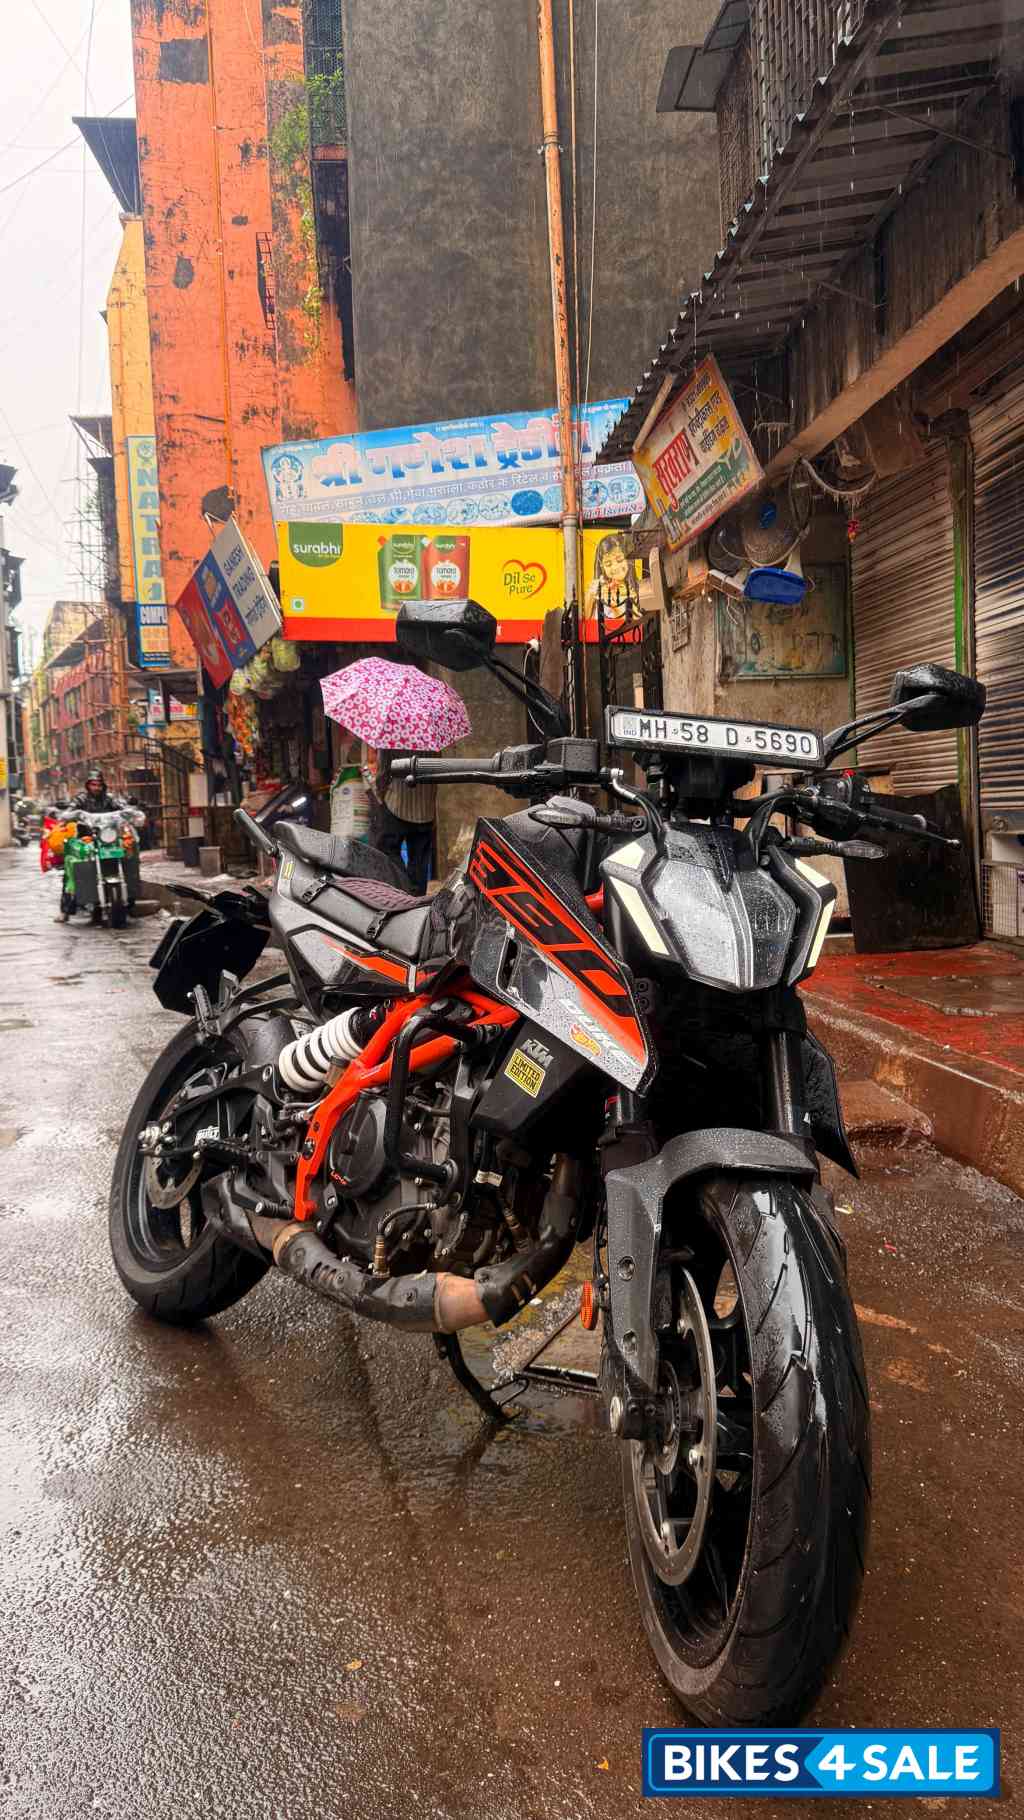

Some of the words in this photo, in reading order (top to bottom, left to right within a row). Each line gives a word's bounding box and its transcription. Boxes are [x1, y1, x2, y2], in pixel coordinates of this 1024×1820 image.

[310, 441, 363, 489] श्री
[366, 431, 488, 480] गणेश
[293, 541, 341, 555] surabhi
[504, 571, 521, 586] Dil
[639, 718, 668, 739] MH
[680, 722, 709, 744] 58
[726, 727, 739, 746] D
[755, 730, 812, 754] 5690
[520, 1039, 554, 1069] KTM
[510, 1063, 537, 1090] EDITION
[514, 1055, 541, 1081] LIMITED
